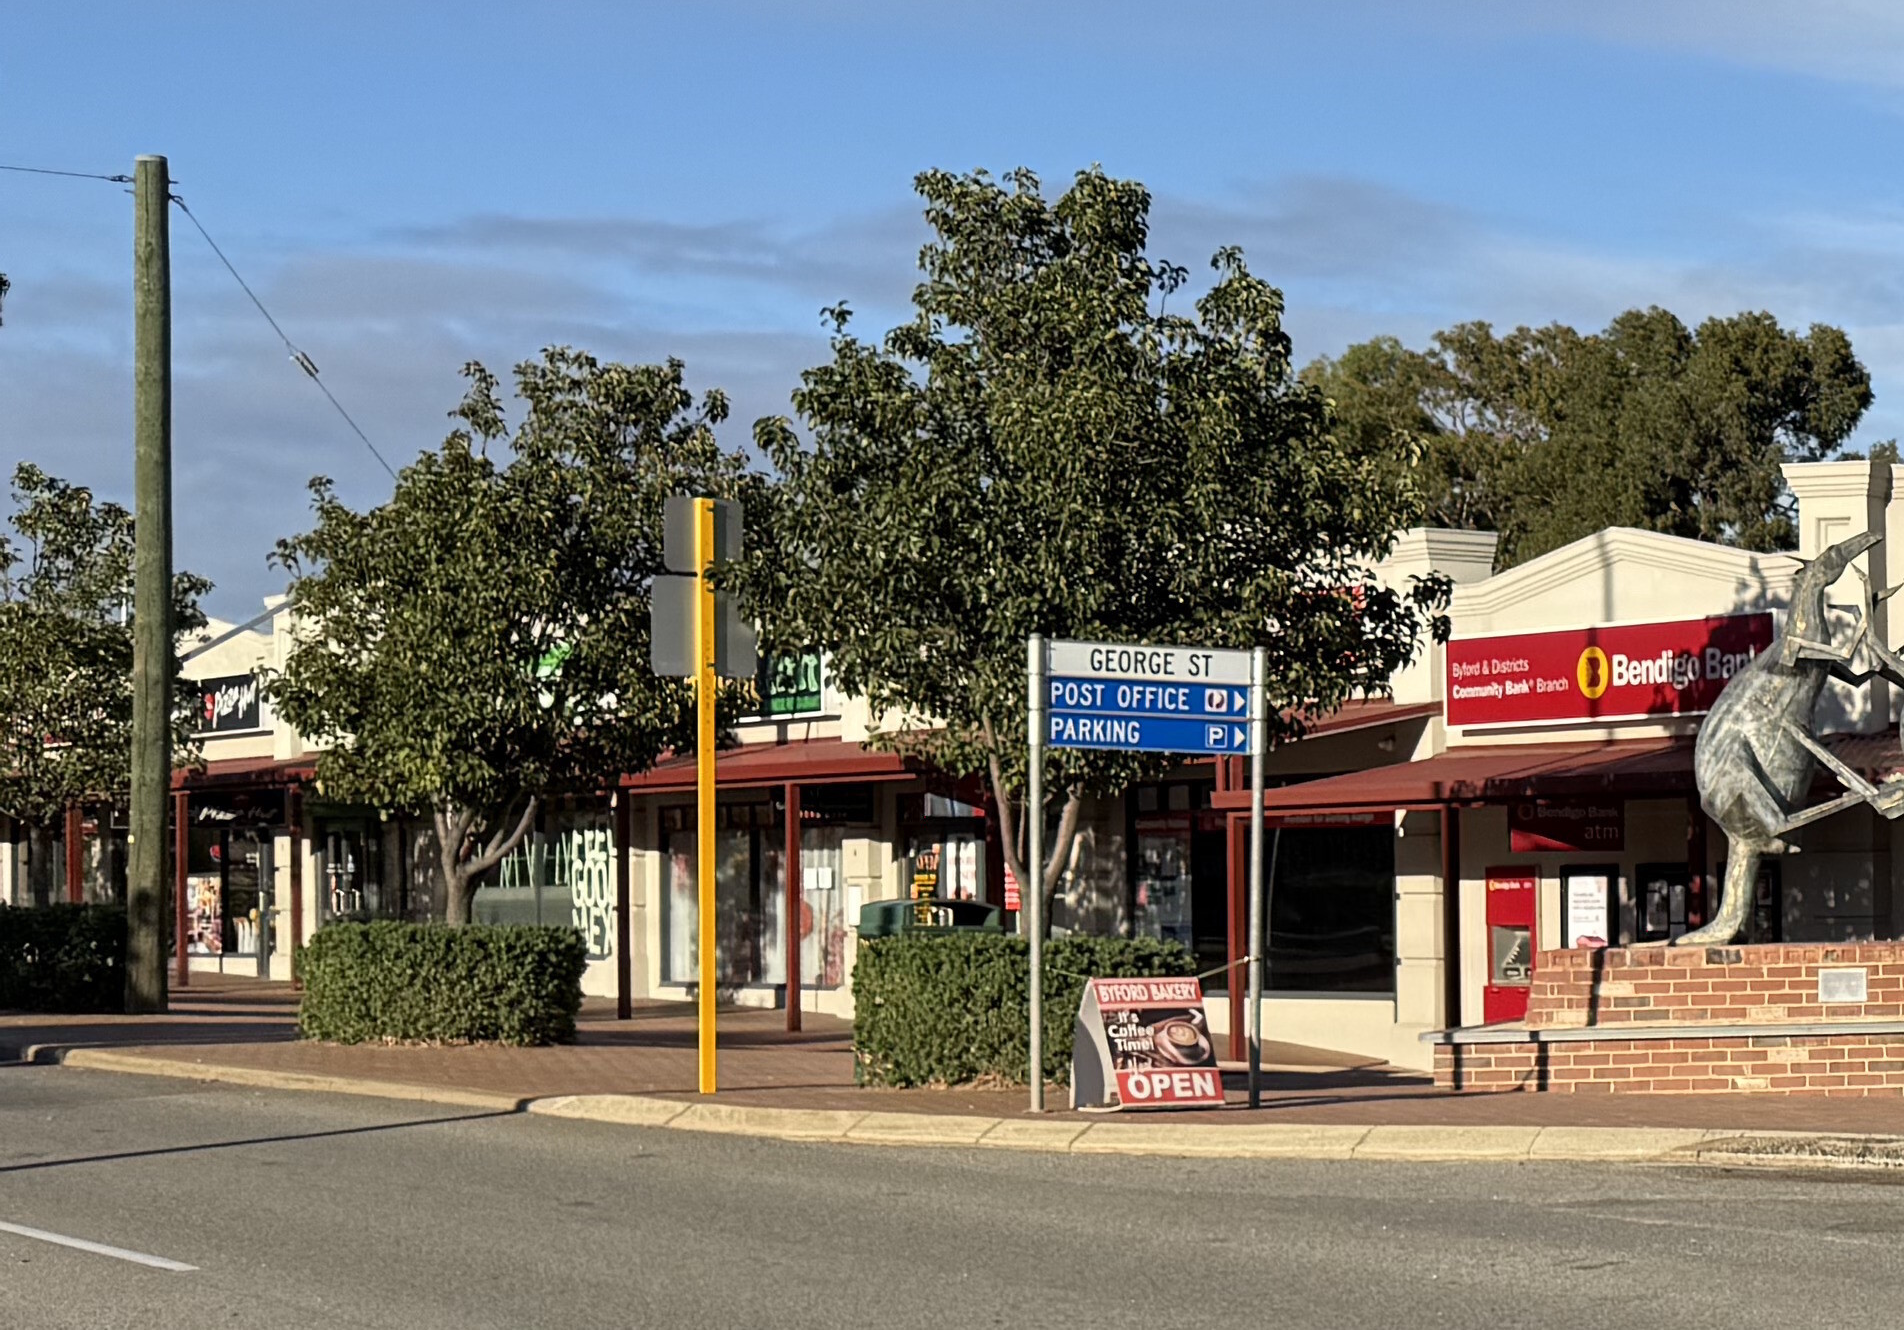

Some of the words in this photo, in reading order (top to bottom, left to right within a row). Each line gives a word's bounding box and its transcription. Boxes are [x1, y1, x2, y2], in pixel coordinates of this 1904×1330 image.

[1090, 649, 1175, 675] GEORGE
[1188, 654, 1213, 677] ST
[1452, 660, 1481, 680] Byford
[1482, 659, 1490, 675] &
[1492, 658, 1529, 674] Districts
[1612, 650, 1700, 690] Bendigo
[1051, 682, 1105, 707] POST
[1117, 685, 1190, 711] OFFICE
[1452, 682, 1503, 699] Community
[1536, 676, 1569, 693] Branch
[1051, 717, 1141, 744] PARKING
[1584, 824, 1619, 840] atm
[1100, 984, 1149, 1003] BYFORD
[1150, 982, 1197, 1000] BAKERY
[1107, 1022, 1155, 1038] Coffee
[1127, 1072, 1216, 1100] OPEN
